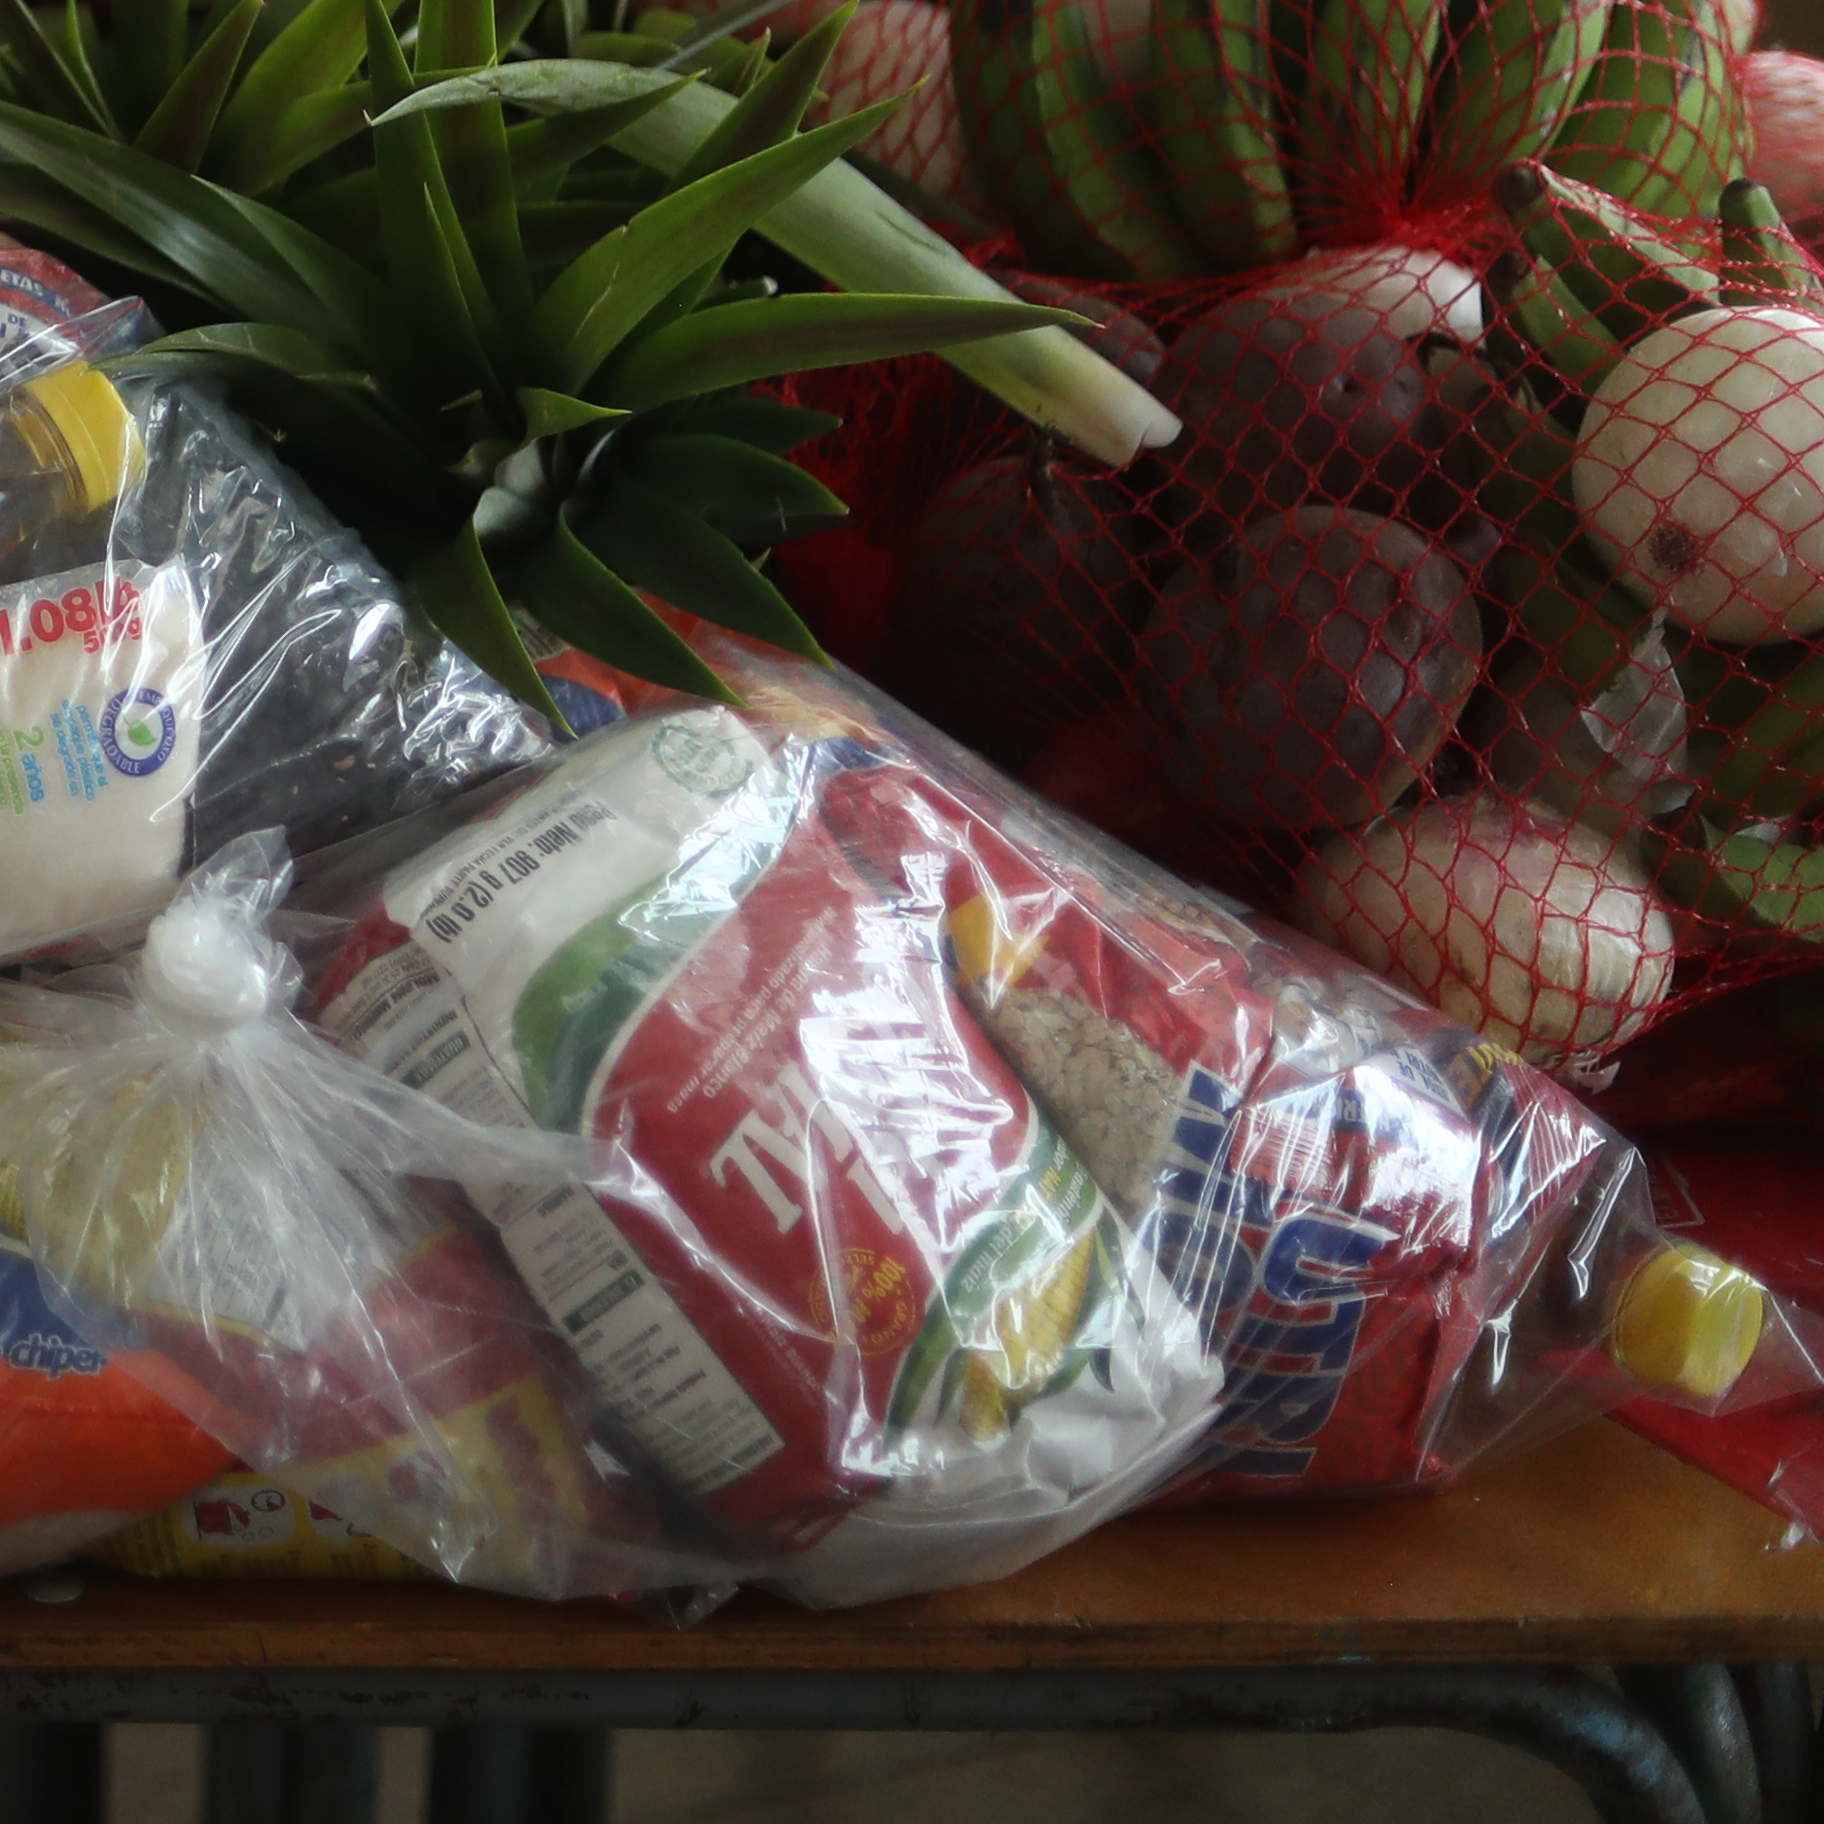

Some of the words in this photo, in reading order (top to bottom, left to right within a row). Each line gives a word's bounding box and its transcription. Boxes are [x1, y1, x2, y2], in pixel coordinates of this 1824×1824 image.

[4, 312, 28, 329] DE
[12, 723, 47, 752] 2
[103, 697, 141, 773] DEGRADABLE
[20, 751, 49, 803] años
[496, 843, 540, 887] 907
[526, 817, 579, 868] Neto:
[423, 906, 464, 948] lb)
[444, 876, 496, 927] (2.0
[986, 1223, 1019, 1259] del
[859, 1254, 909, 1308] 100%
[6, 1329, 109, 1387] chiper
[1220, 1204, 1404, 1478] UTRI
